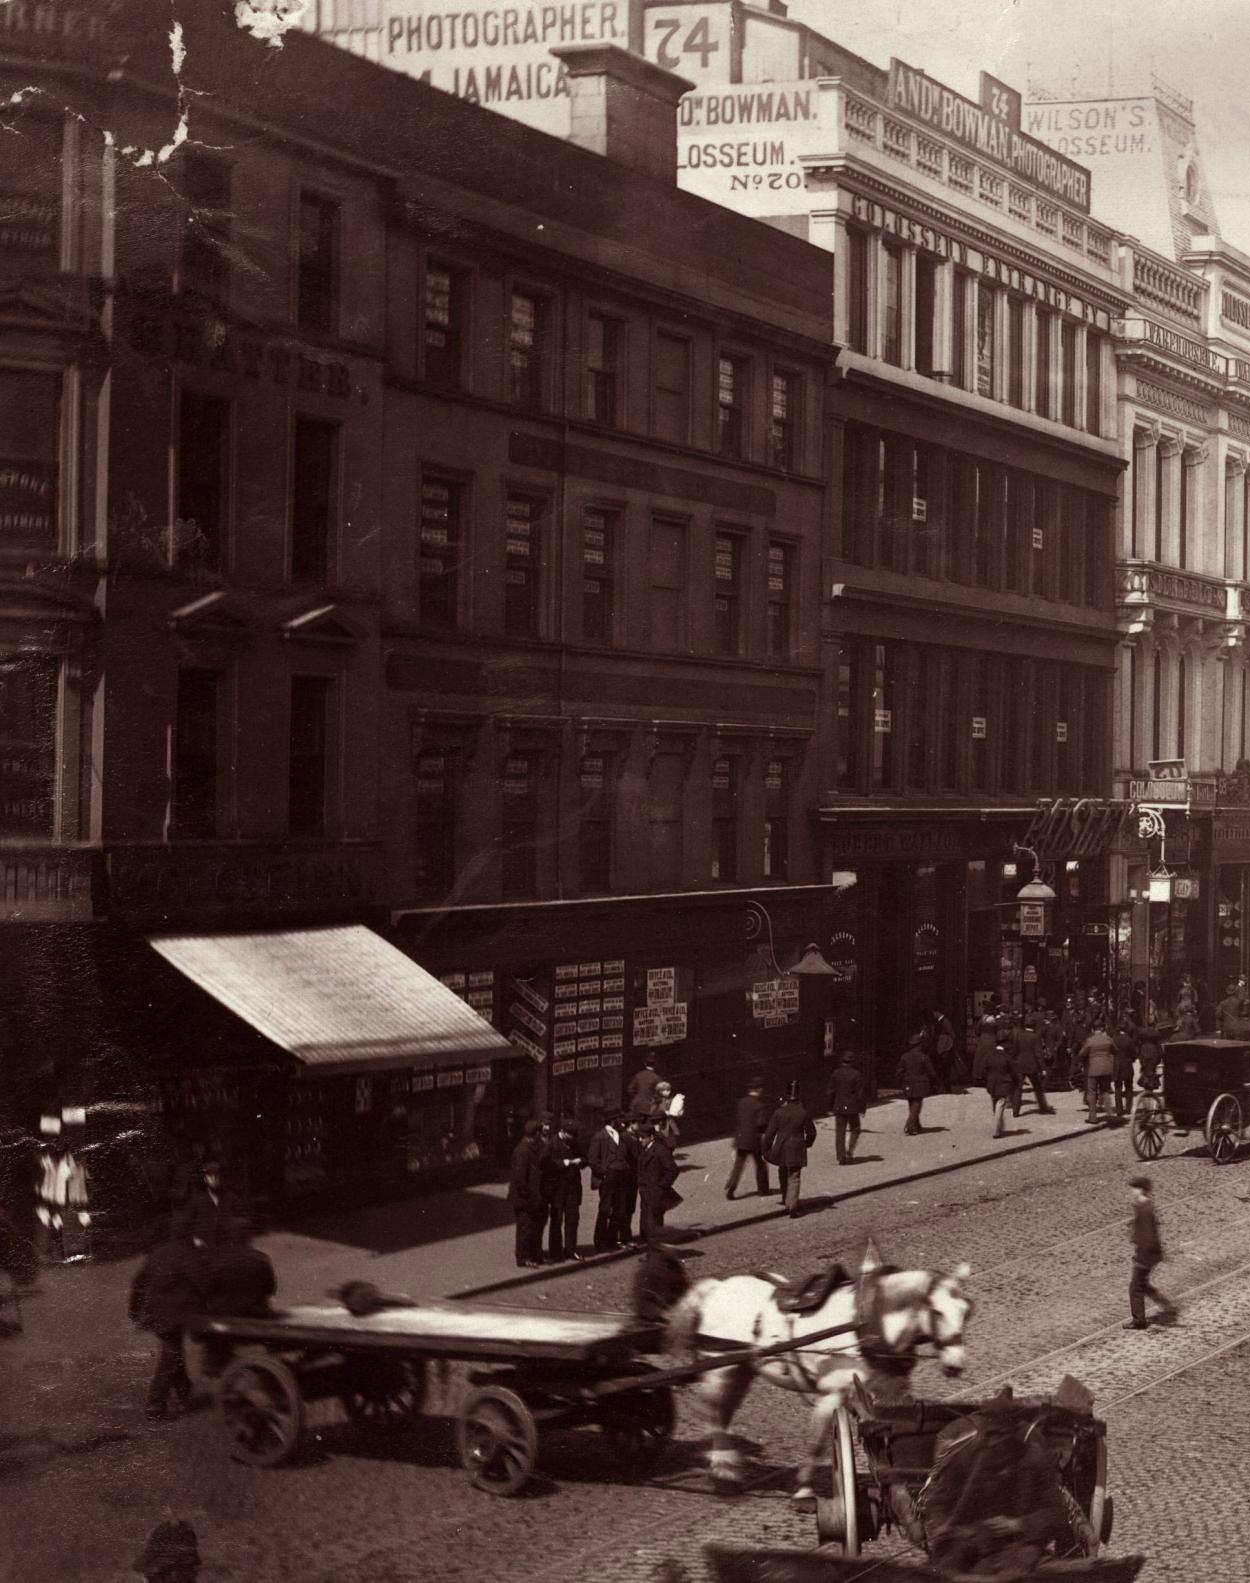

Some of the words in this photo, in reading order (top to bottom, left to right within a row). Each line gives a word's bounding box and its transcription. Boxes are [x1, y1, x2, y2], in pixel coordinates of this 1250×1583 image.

[388, 4, 626, 53] PHOTOGRAPHER.
[652, 17, 719, 69] 74
[706, 89, 818, 125] BOWMAN.
[677, 141, 795, 169] OSSEUM.
